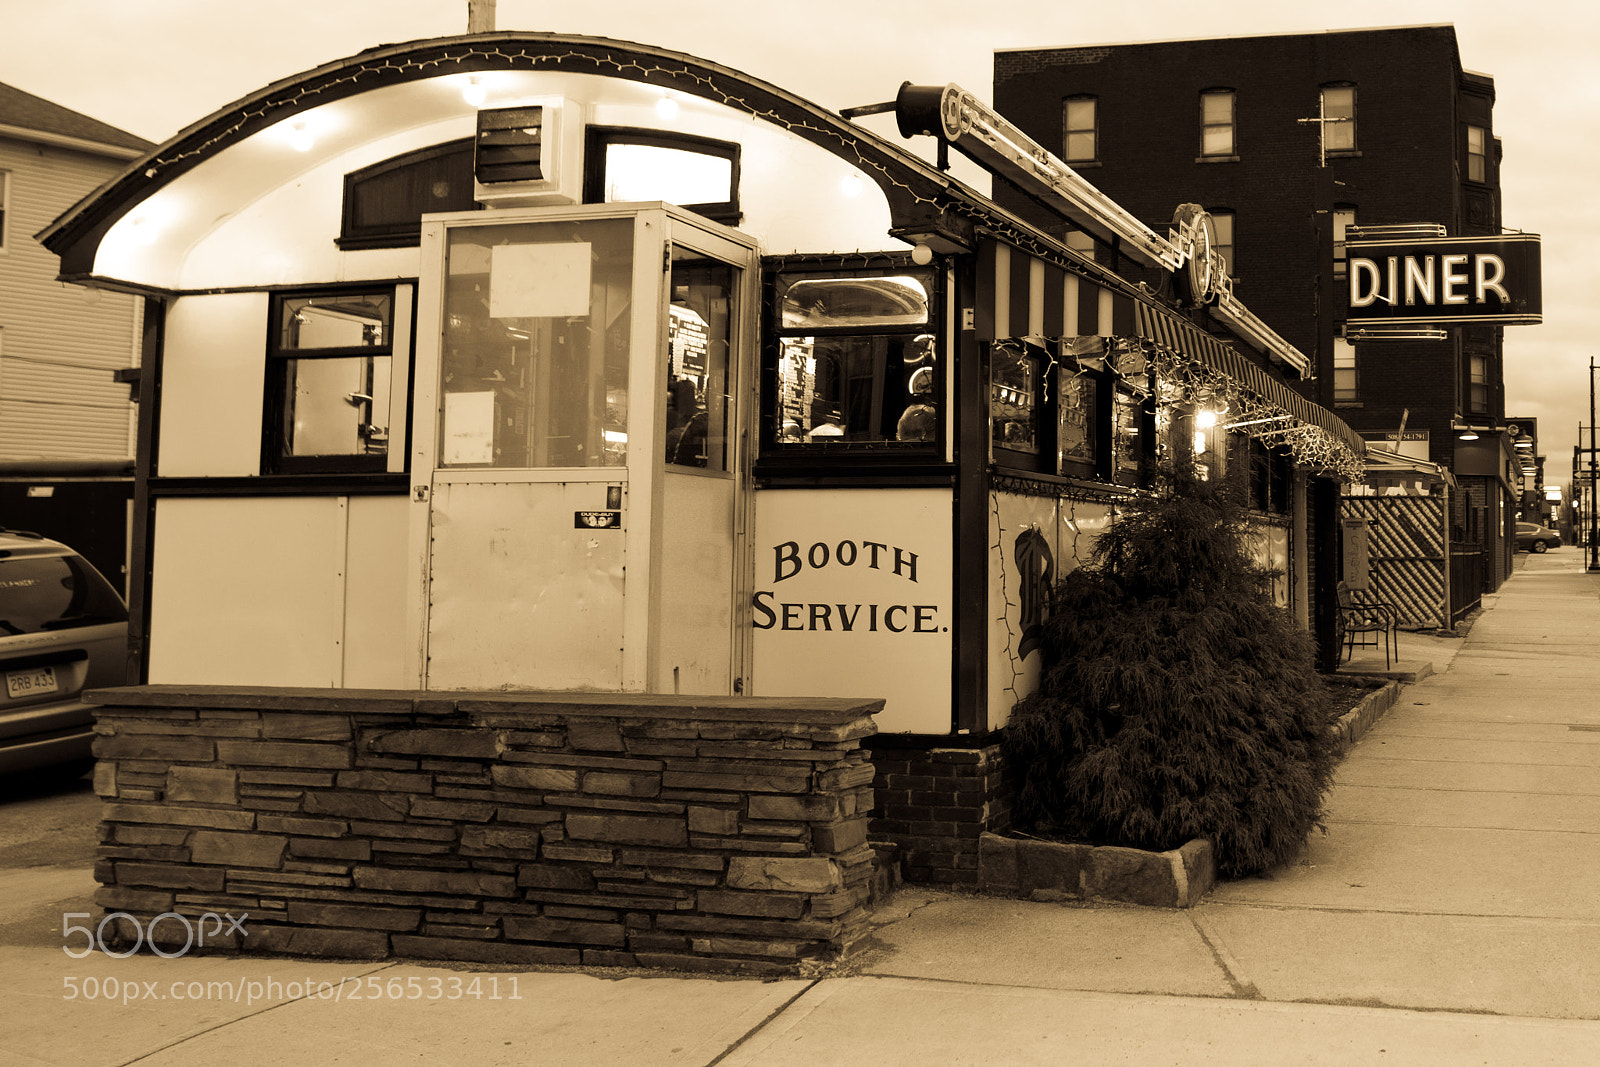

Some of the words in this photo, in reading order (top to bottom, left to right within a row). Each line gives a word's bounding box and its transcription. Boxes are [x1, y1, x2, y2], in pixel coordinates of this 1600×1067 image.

[1350, 254, 1511, 307] DINER
[773, 540, 919, 583] BOOTH
[753, 591, 948, 633] SERVICE.
[11, 676, 31, 691] 2RB
